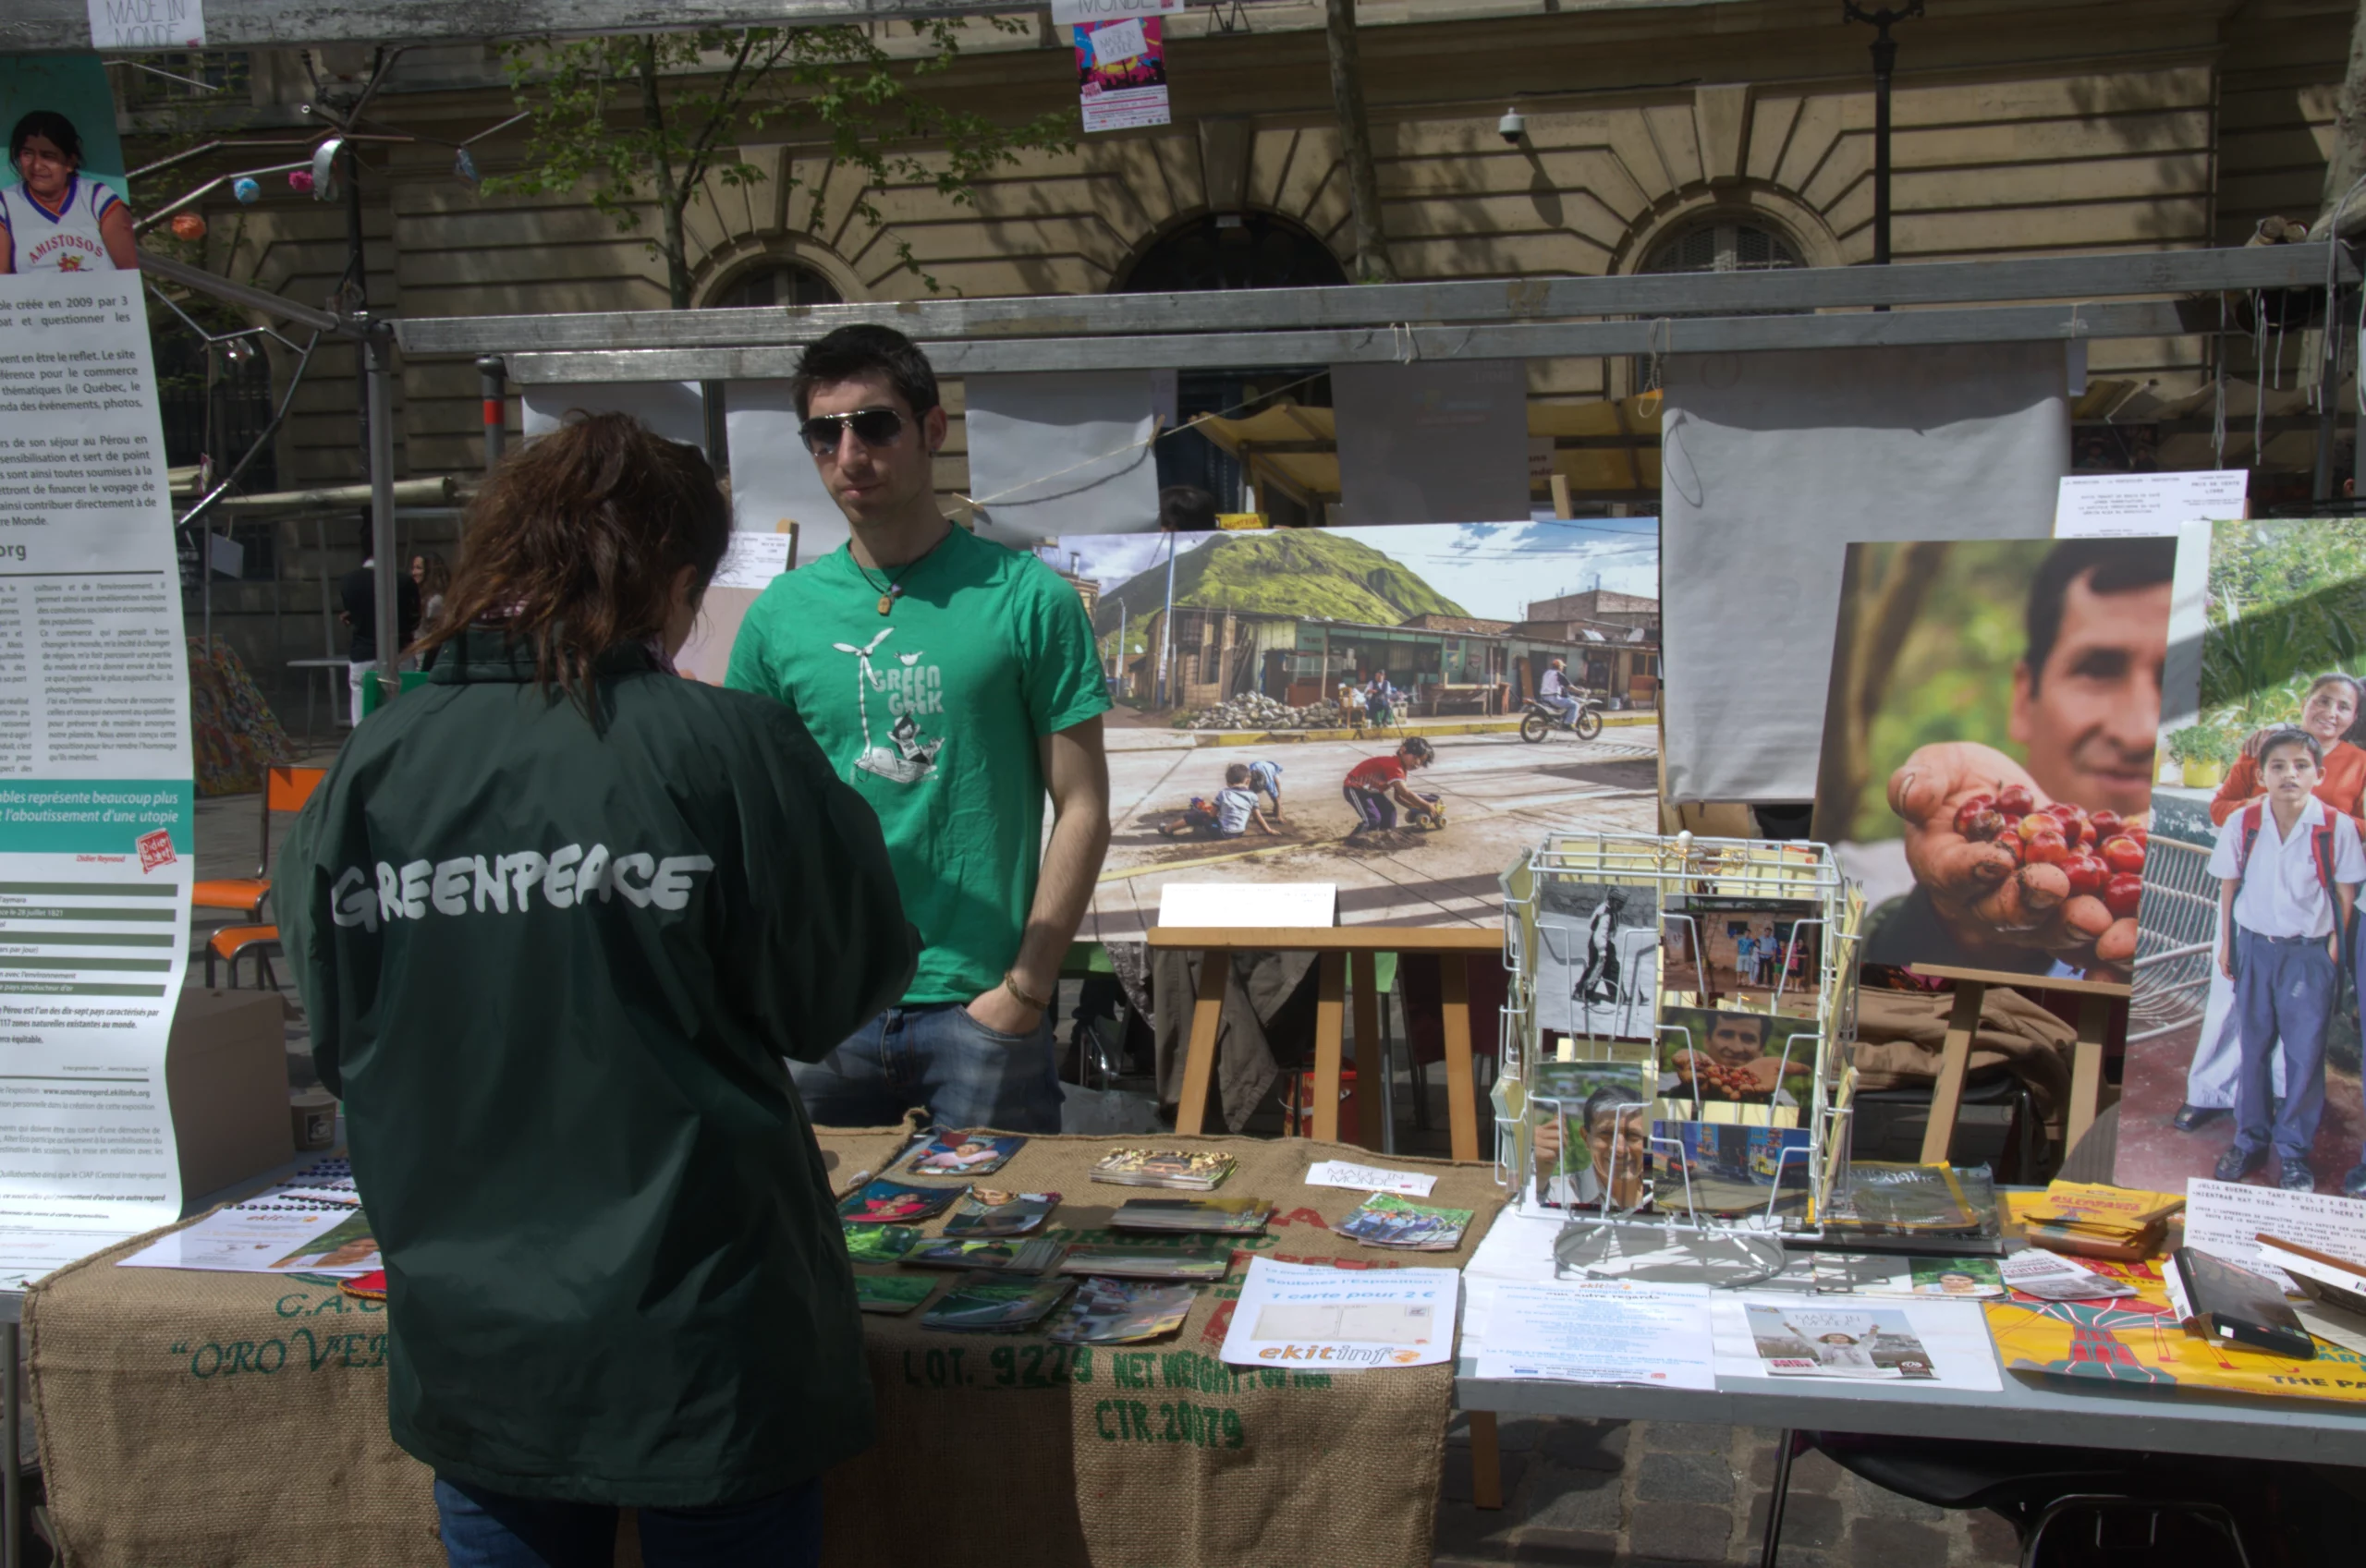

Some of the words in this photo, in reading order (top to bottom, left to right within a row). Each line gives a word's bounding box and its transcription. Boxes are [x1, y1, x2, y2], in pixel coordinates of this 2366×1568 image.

[105, 0, 164, 26] MADE
[166, 0, 186, 21] IN
[114, 22, 181, 49] MONDE
[29, 234, 104, 264] AMISTOSOS
[872, 664, 942, 693] GREEN
[888, 690, 945, 716] GEEK
[331, 843, 716, 933] GREENPEACE
[2198, 1183, 2222, 1192] JULIA
[2225, 1186, 2253, 1196] GUERRA
[2267, 1191, 2287, 1199] TANT
[2299, 1205, 2325, 1215] WHILE
[990, 1344, 1093, 1387] 9229
[1112, 1352, 1158, 1389] NET
[2267, 1375, 2329, 1387] THE
